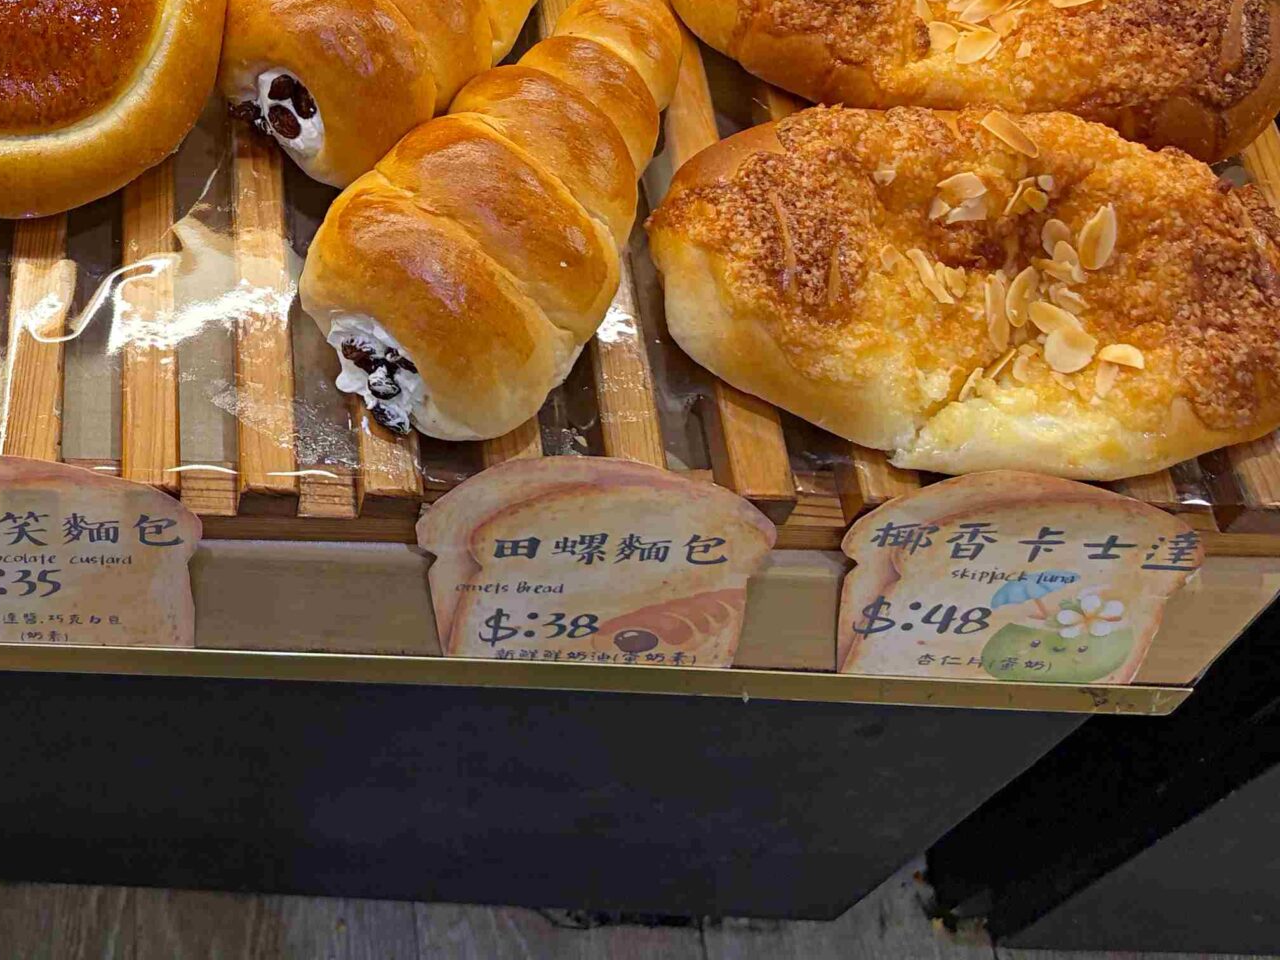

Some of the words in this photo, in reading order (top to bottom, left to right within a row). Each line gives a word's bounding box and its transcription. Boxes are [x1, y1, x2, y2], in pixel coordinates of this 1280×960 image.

[494, 532, 729, 565] 田螺麵包
[870, 522, 1201, 572] 椰香卡士達
[70, 554, 133, 566] custard
[951, 567, 1028, 584] skipjack
[516, 580, 564, 594] Bread
